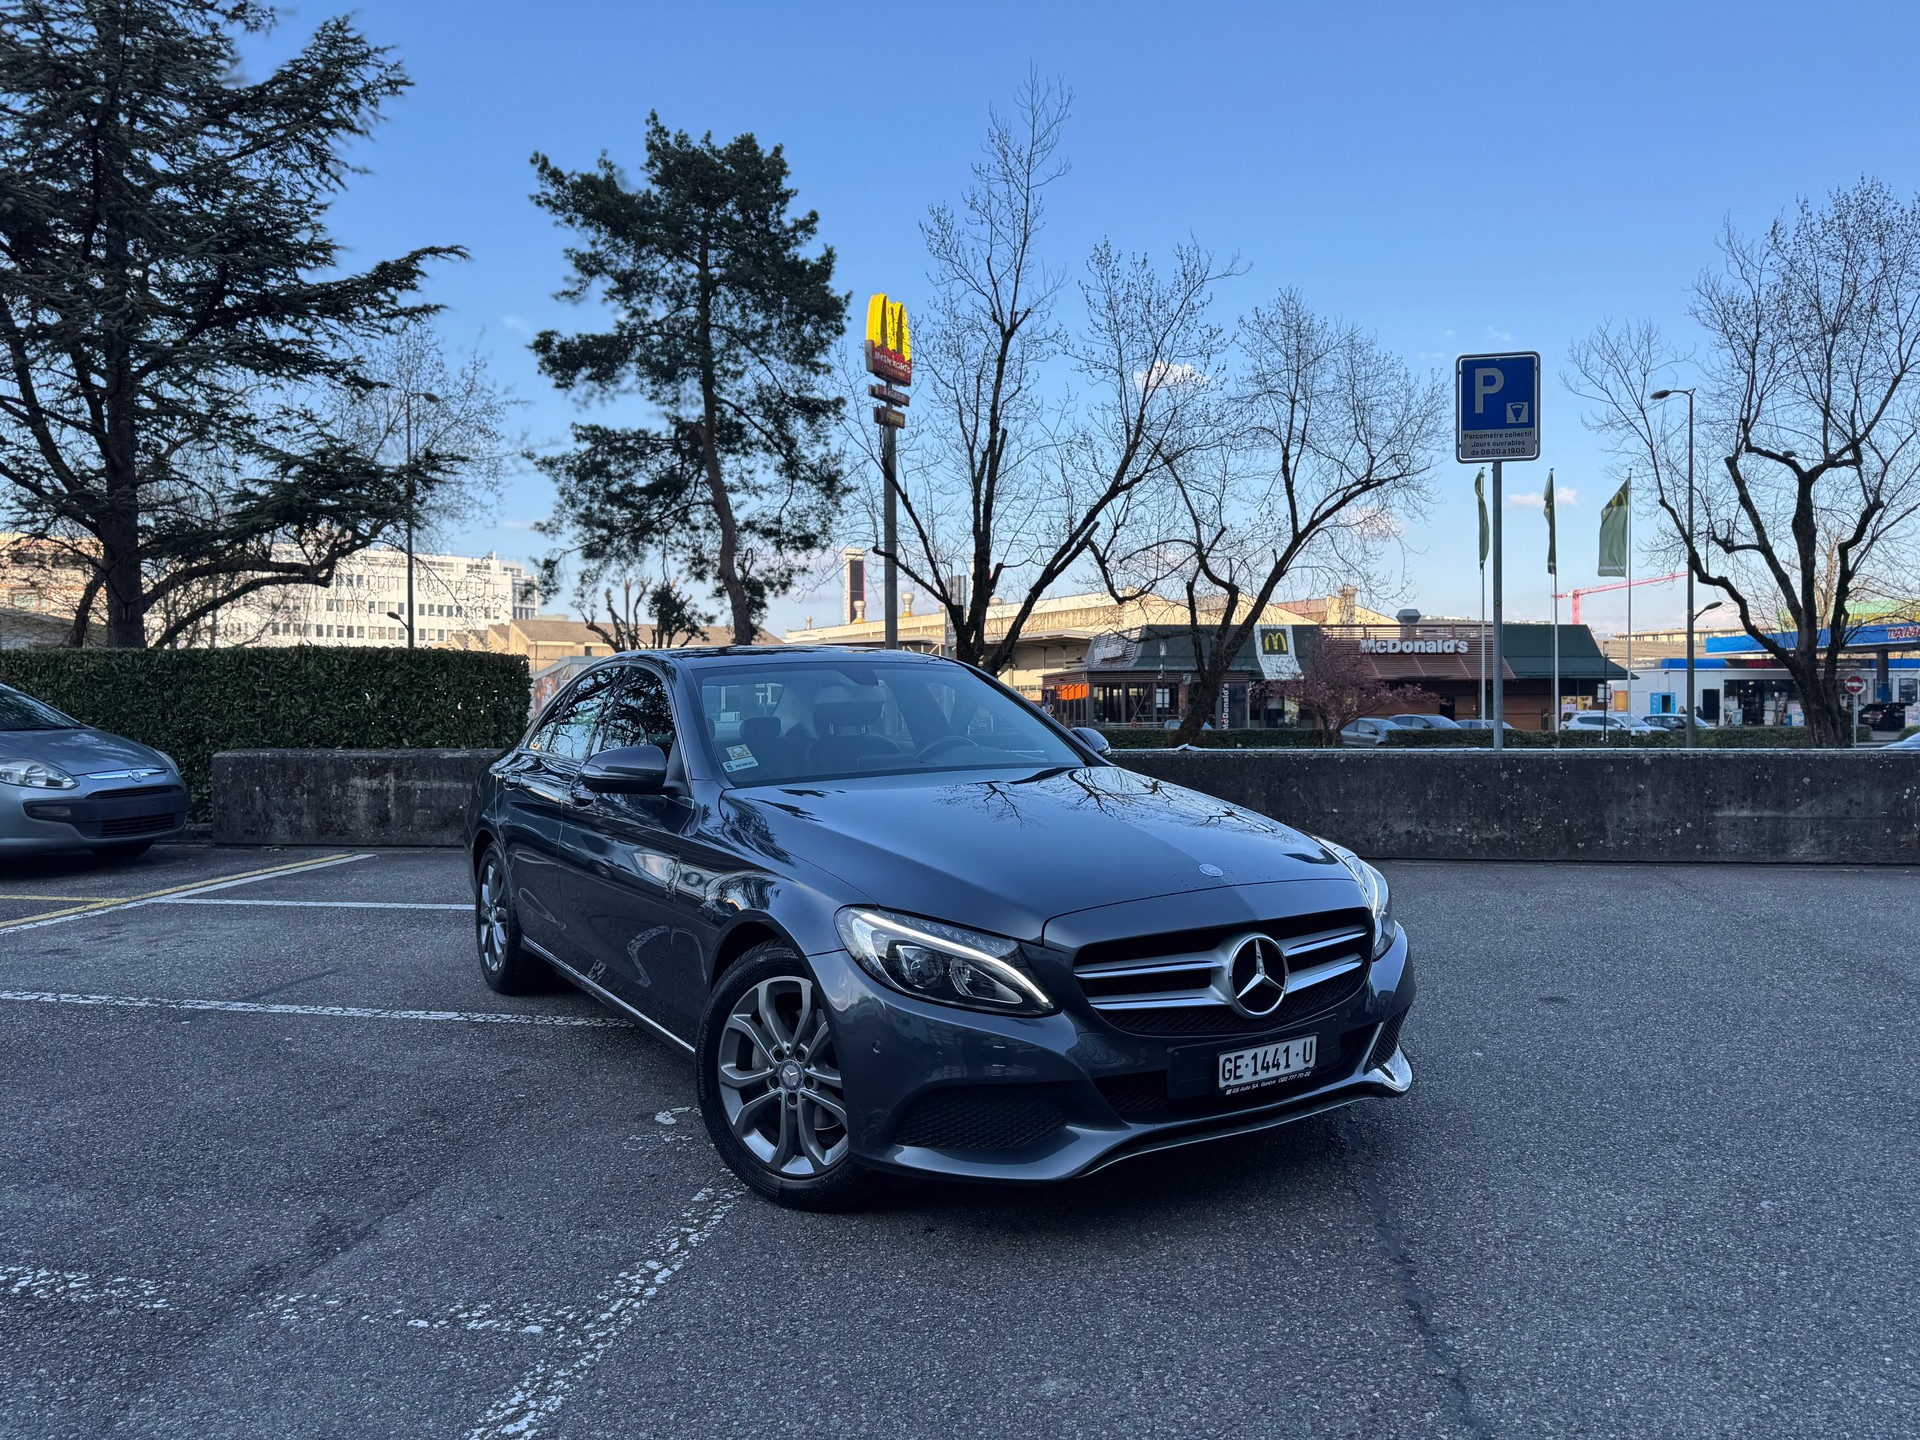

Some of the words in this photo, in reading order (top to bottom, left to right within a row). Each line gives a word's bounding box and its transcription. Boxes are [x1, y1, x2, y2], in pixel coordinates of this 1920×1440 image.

[1475, 368, 1504, 413] P
[1464, 432, 1503, 440] Parcomètre
[1887, 625, 1920, 640] TAM
[1360, 639, 1469, 654] McDonald's
